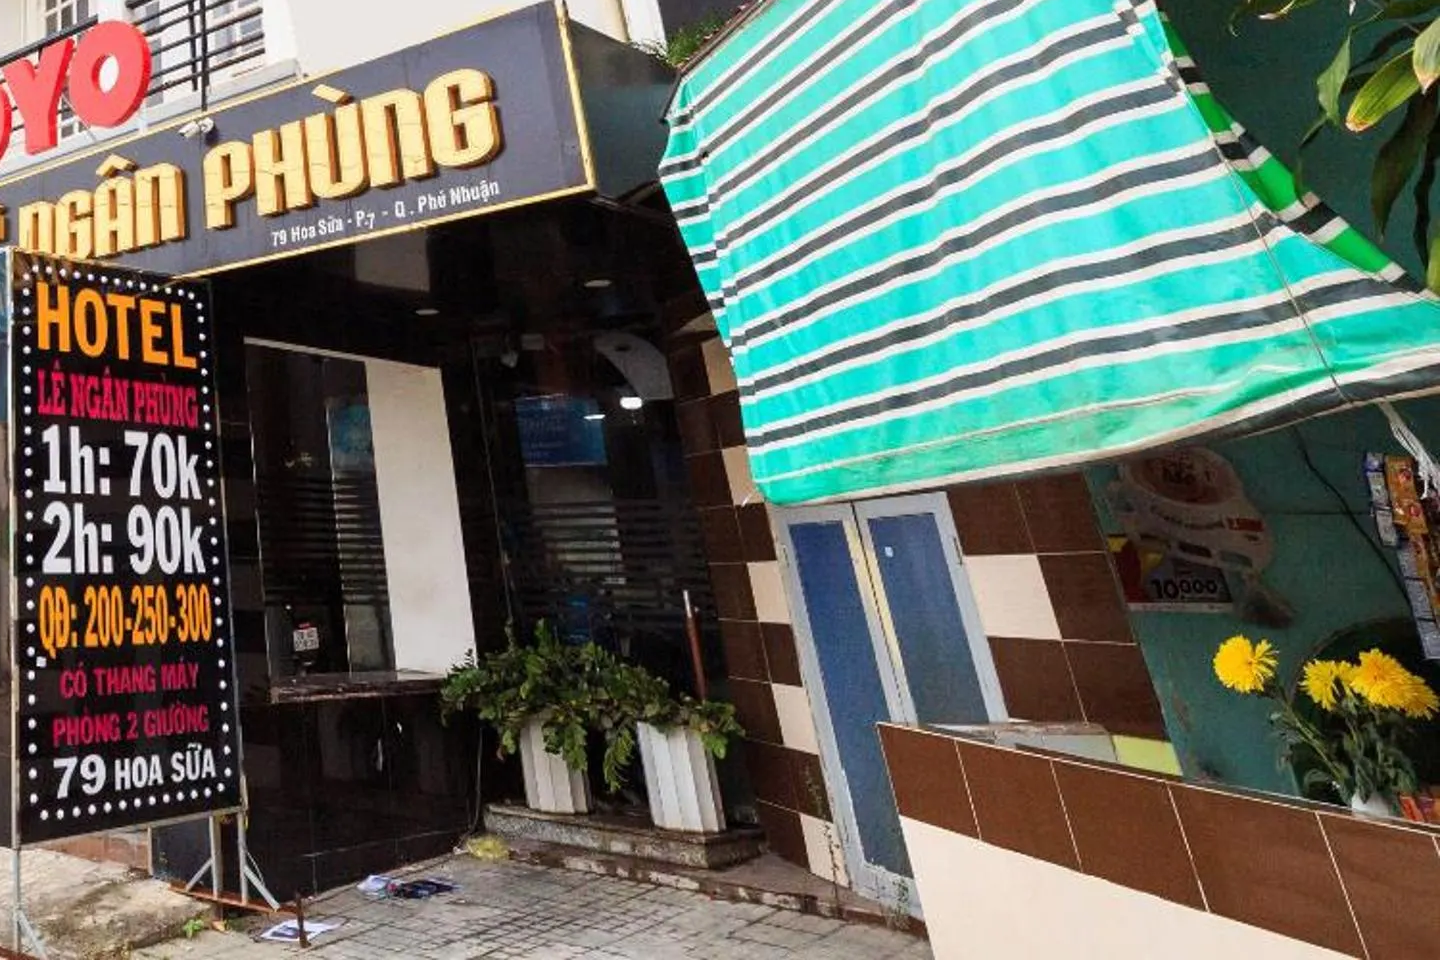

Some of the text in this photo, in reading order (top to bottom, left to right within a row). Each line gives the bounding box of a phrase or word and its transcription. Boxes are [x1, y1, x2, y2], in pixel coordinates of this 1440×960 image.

[271, 229, 288, 247] 79
[290, 225, 317, 243] Hoa
[448, 179, 501, 207] Nhuận
[36, 281, 197, 369] HOTEL
[37, 358, 199, 429] LÊ NGÂN PHÙNG
[41, 424, 203, 500] 1h: 70k
[41, 500, 206, 575] 2h: 90k
[83, 583, 211, 648] 200-250-300
[60, 656, 199, 699] CÓ THANG MÁY
[52, 706, 121, 748] PHÒNG
[126, 711, 139, 740] 2
[53, 742, 217, 799] 79 HOA SỮA
